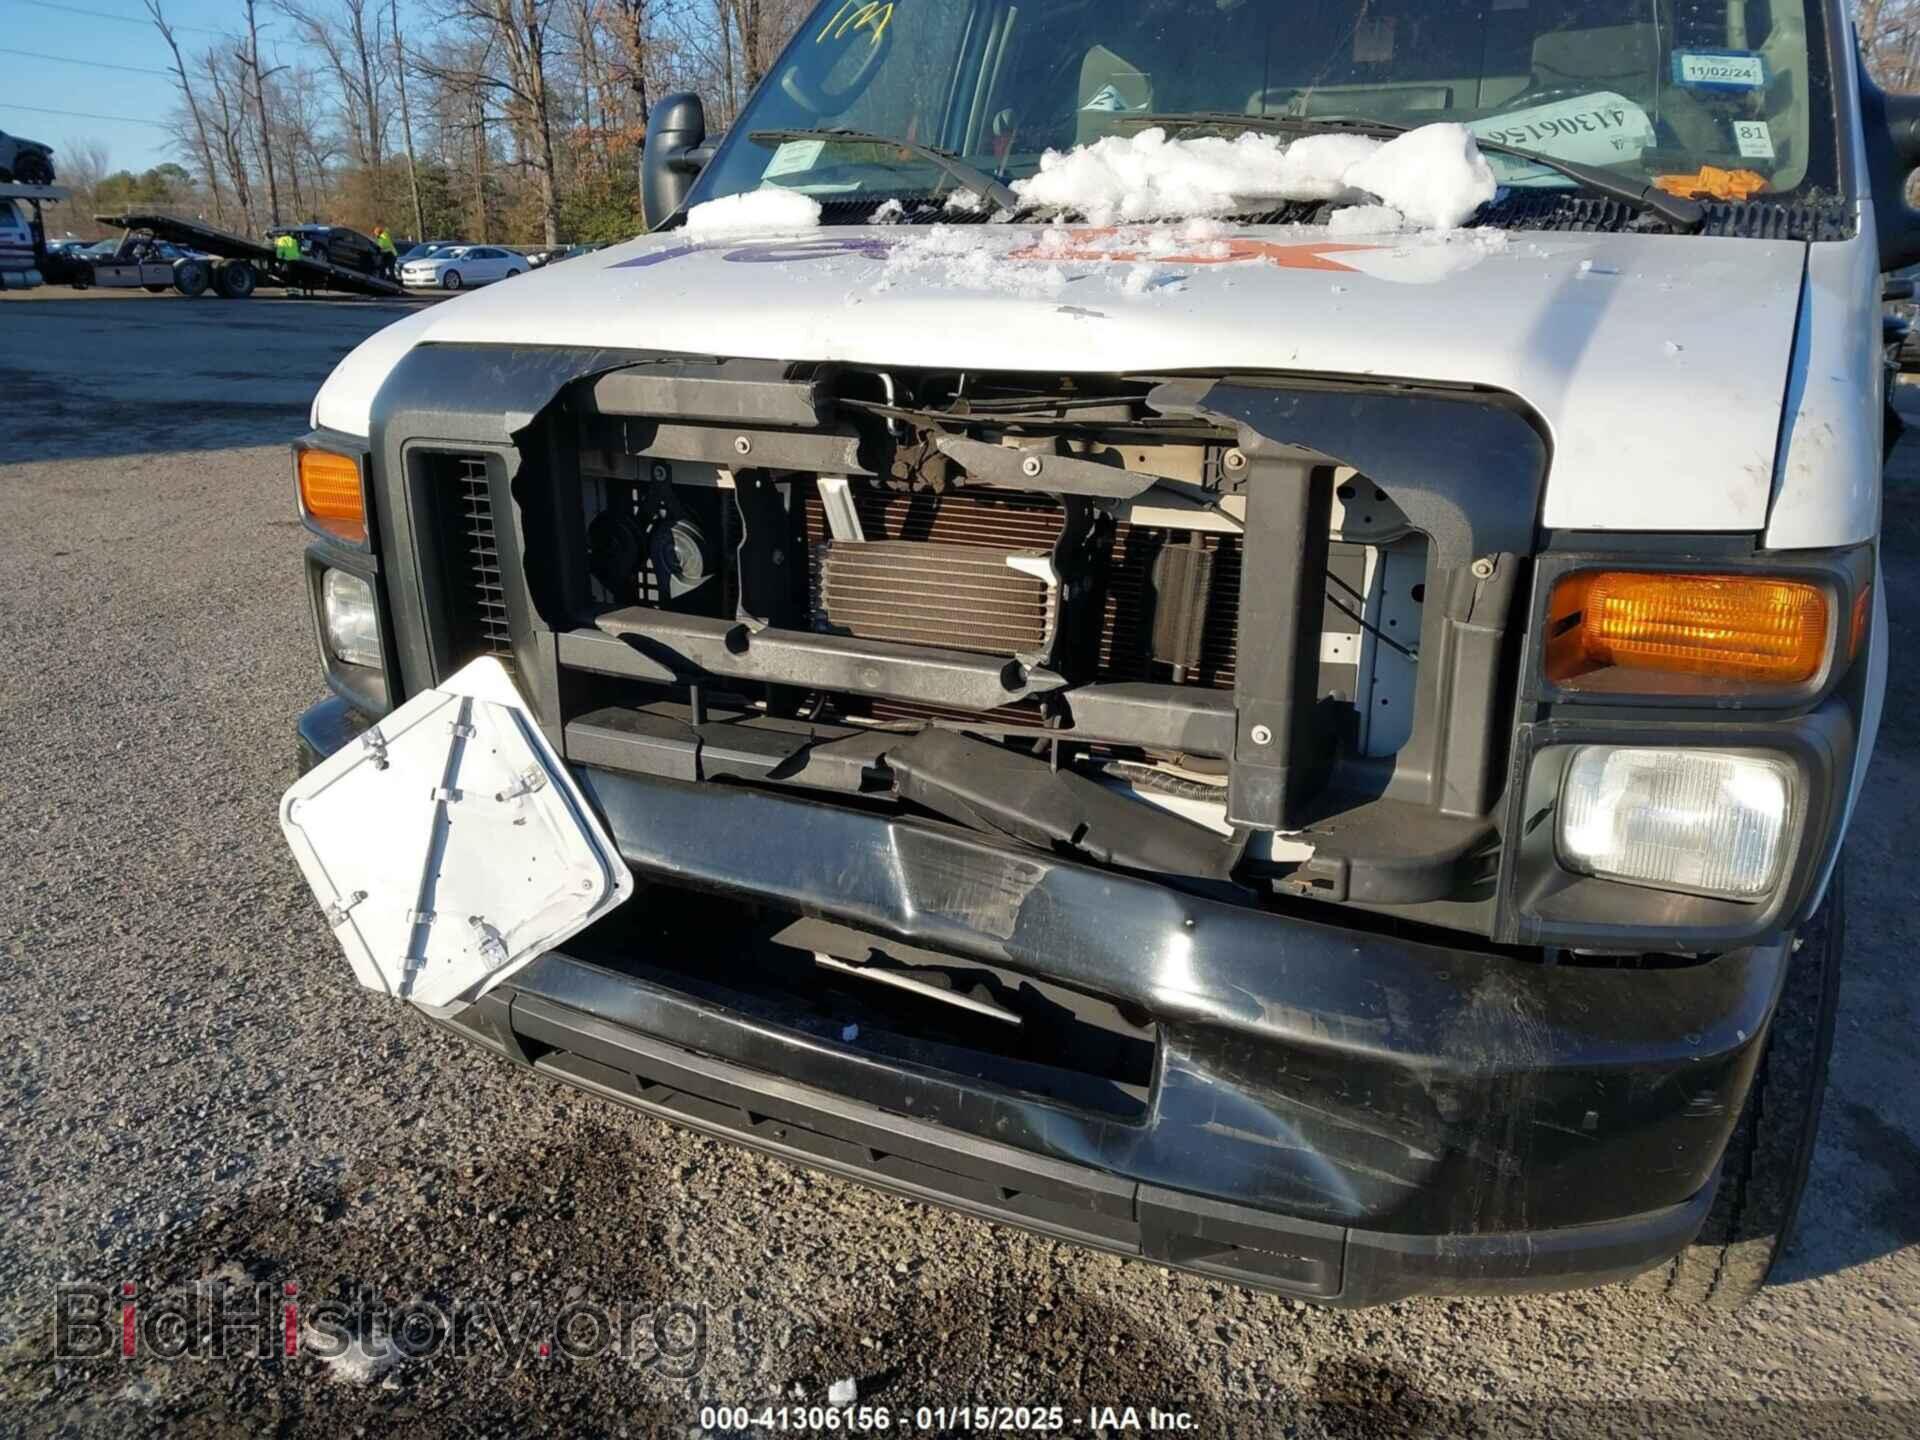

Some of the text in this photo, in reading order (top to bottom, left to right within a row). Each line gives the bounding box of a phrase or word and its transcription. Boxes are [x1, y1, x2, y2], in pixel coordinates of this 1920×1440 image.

[1688, 66, 1753, 79] 11/02/24
[1487, 108, 1625, 145] 41306156
[1740, 126, 1766, 140] 81
